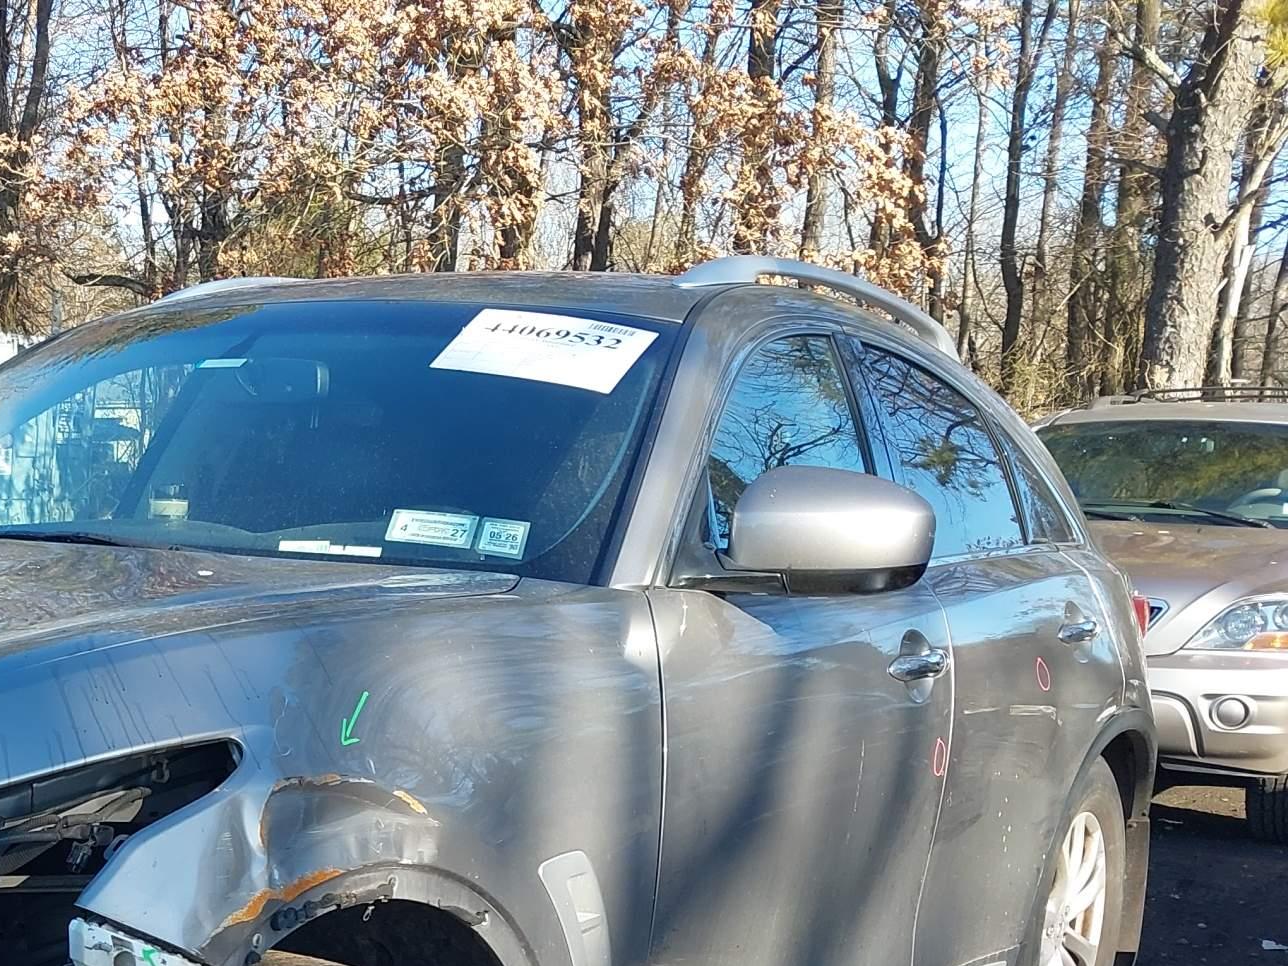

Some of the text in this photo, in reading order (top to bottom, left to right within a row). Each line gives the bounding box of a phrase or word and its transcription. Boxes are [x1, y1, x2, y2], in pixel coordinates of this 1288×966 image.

[484, 322, 623, 350] 44069532
[450, 528, 468, 538] 27
[489, 530, 519, 541] 05 26
